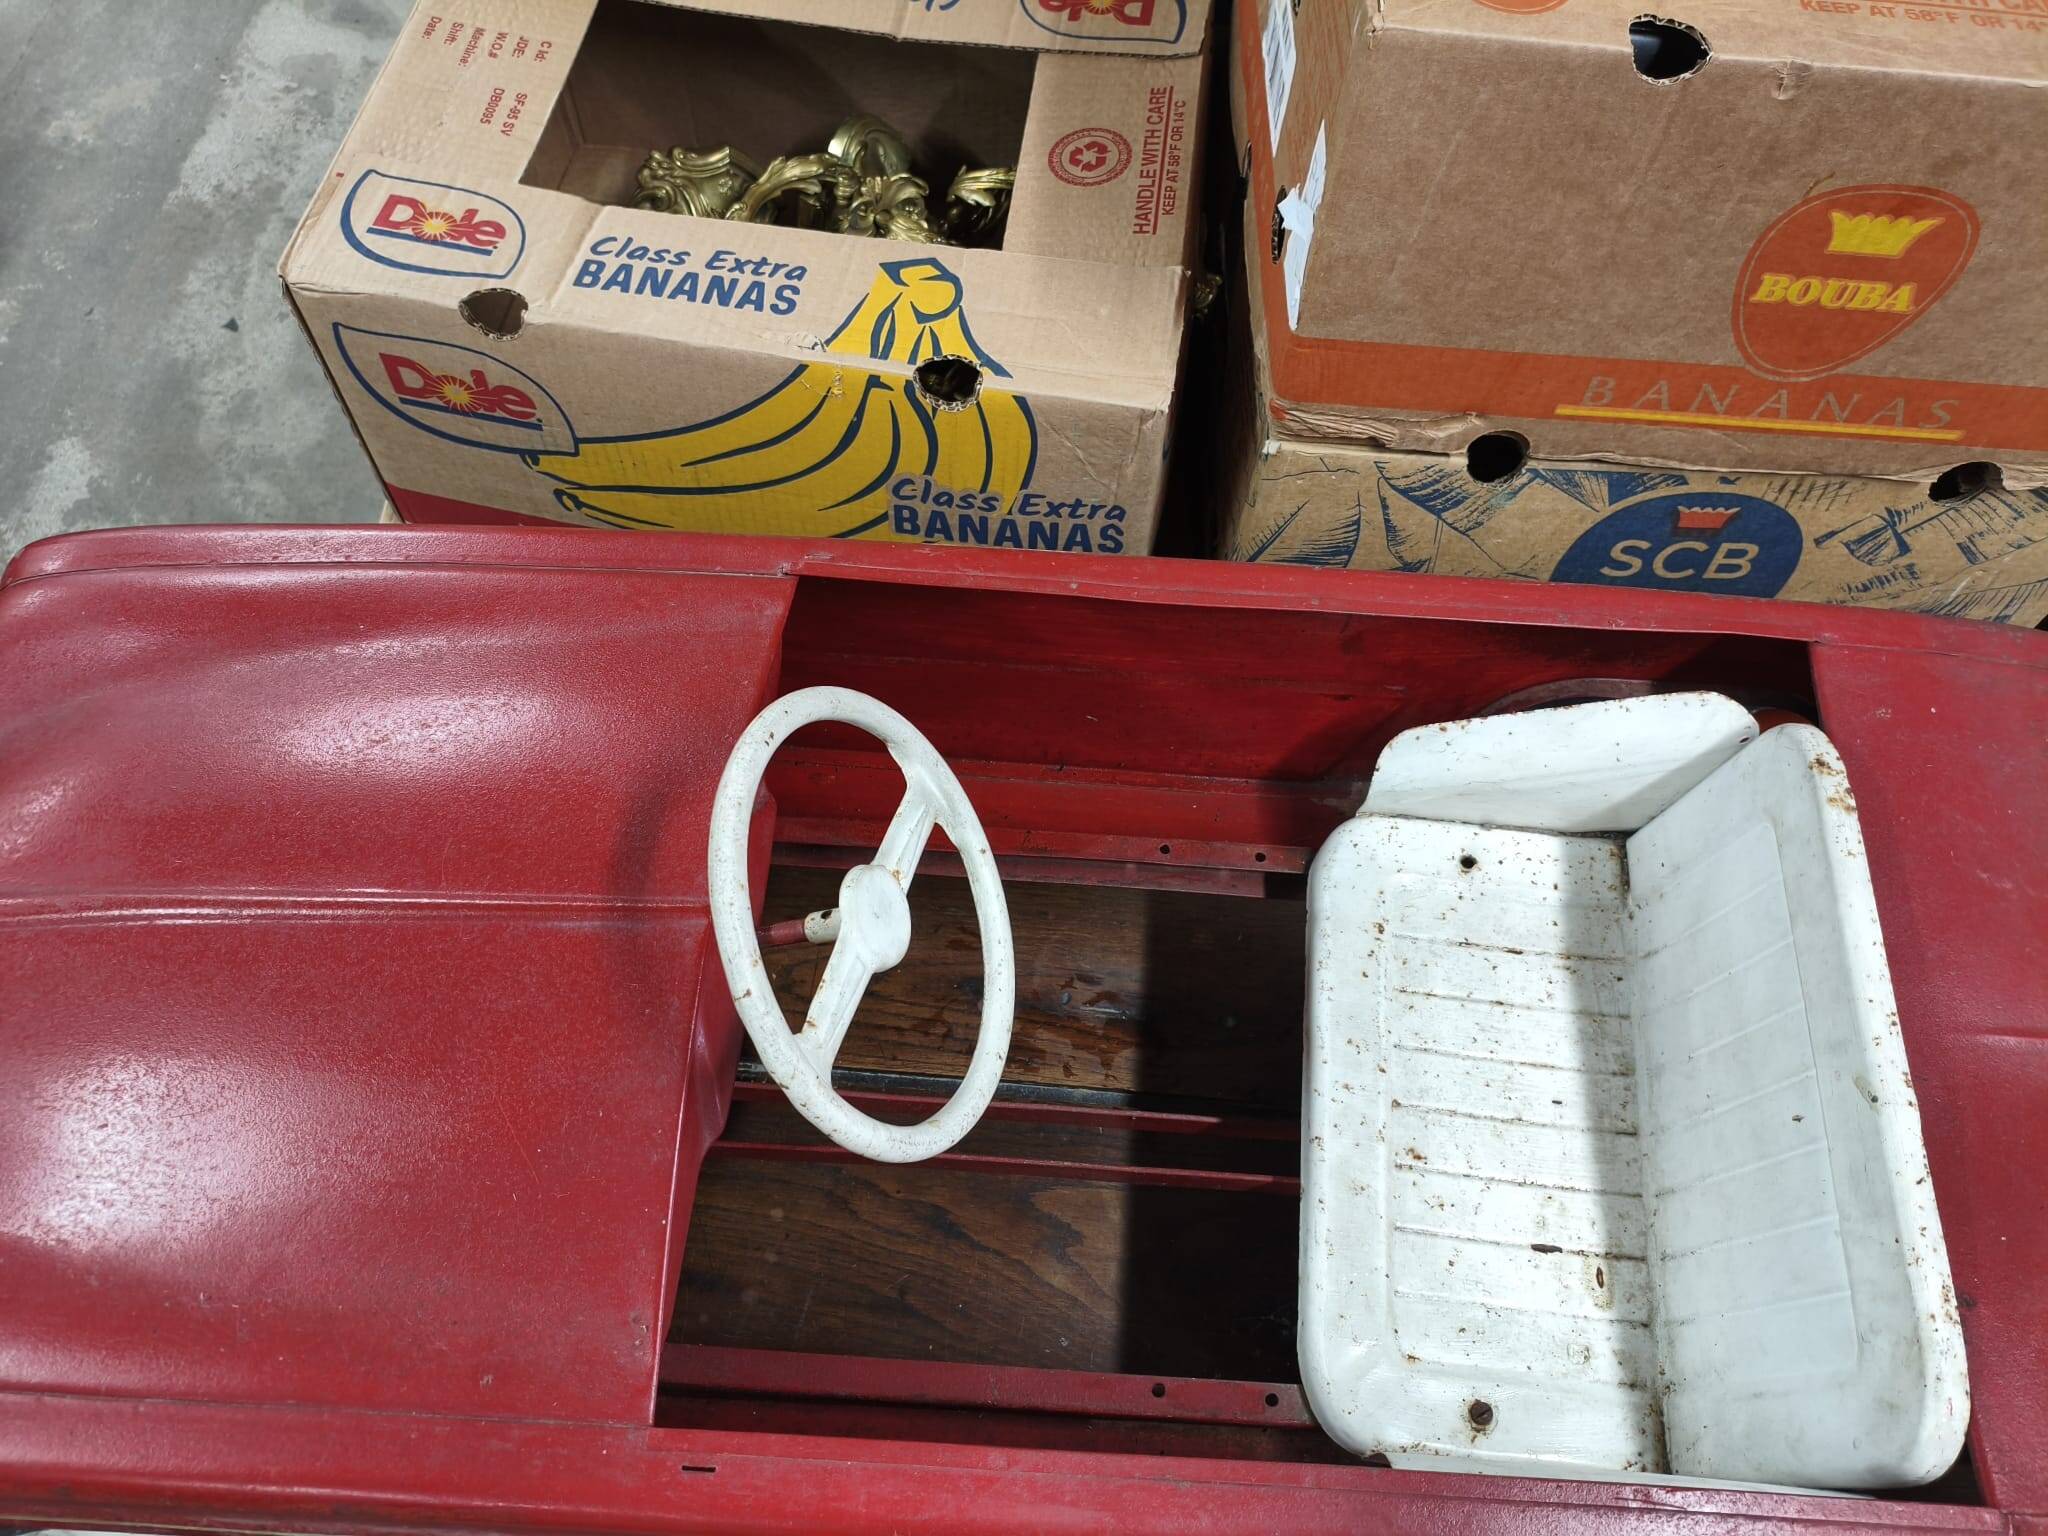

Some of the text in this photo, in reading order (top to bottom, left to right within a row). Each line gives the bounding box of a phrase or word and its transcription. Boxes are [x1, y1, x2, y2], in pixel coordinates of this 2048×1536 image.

[422, 16, 442, 40] Date:
[443, 21, 464, 46] Shift:
[1801, 1, 1861, 15] KEEP
[1870, 5, 1897, 19] AT
[1969, 14, 2006, 29] OR
[458, 27, 487, 67] Machine:
[512, 36, 529, 59] JDE:
[507, 92, 528, 121] SF-95
[500, 121, 515, 136] SV
[1170, 125, 1184, 142] OR
[1133, 87, 1168, 235] HANDLE WITH CARE
[1166, 169, 1178, 184] AT
[372, 194, 507, 247] Dole
[1161, 185, 1177, 216] KEEP
[590, 236, 808, 282] Class Extra
[572, 259, 801, 316] BANANAS
[1750, 273, 1917, 315] BOUBA
[378, 353, 537, 420] Dole
[1582, 376, 1960, 429] BANANAS
[892, 477, 1127, 523] Class Extra
[893, 504, 1125, 554] BANANAS
[1600, 539, 1760, 580] SCB
